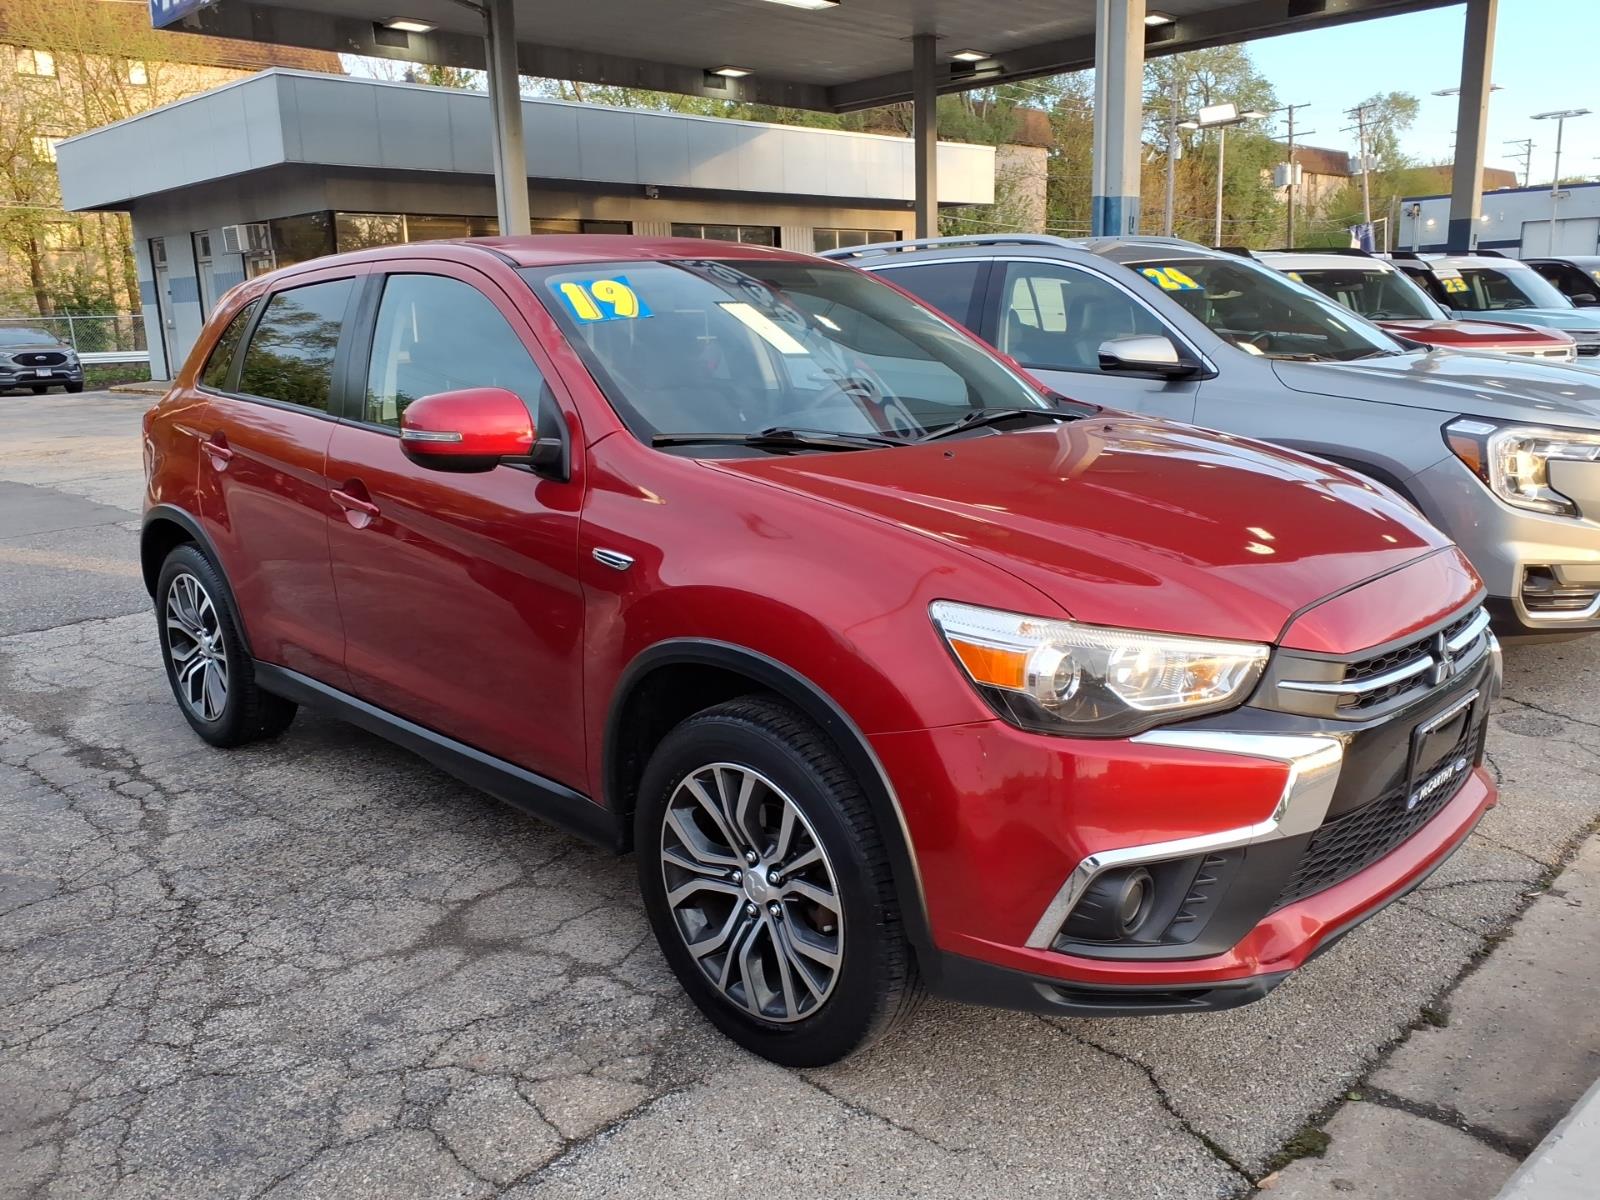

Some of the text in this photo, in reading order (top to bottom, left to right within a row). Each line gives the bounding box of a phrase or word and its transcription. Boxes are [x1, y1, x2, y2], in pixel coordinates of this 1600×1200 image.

[1143, 267, 1199, 290] 24
[560, 279, 639, 320] 19
[1419, 765, 1455, 801] McCARTHY
